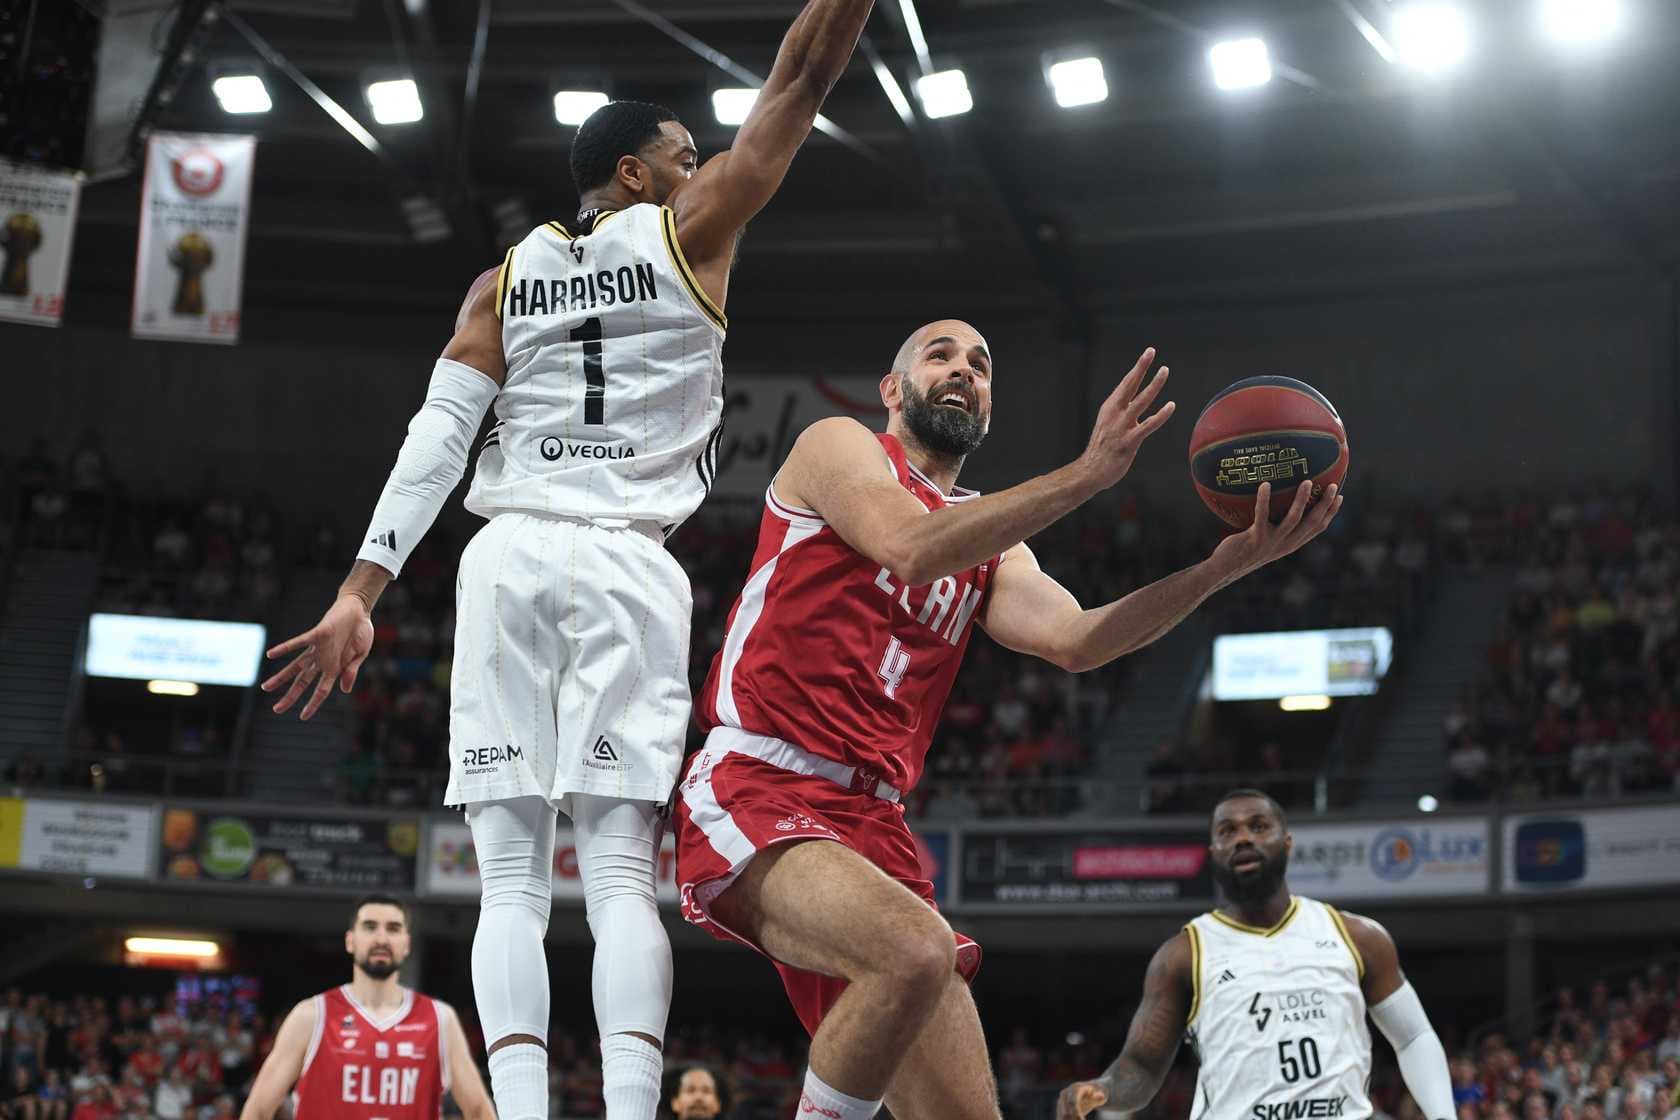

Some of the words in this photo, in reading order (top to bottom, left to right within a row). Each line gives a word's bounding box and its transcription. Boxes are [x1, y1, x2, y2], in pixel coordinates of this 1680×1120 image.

[509, 262, 658, 316] HARRISON
[570, 317, 605, 425] 1
[567, 444, 636, 460] VEOLIA
[1216, 458, 1309, 487] LEGACY
[877, 634, 911, 700] 4
[464, 766, 498, 775] assurances
[1278, 992, 1325, 1011] LDLC
[1282, 1009, 1327, 1023] ASVEL
[1278, 1037, 1322, 1084] 50
[342, 1064, 420, 1105] ELAN
[1252, 1096, 1349, 1120] SKWEEK
